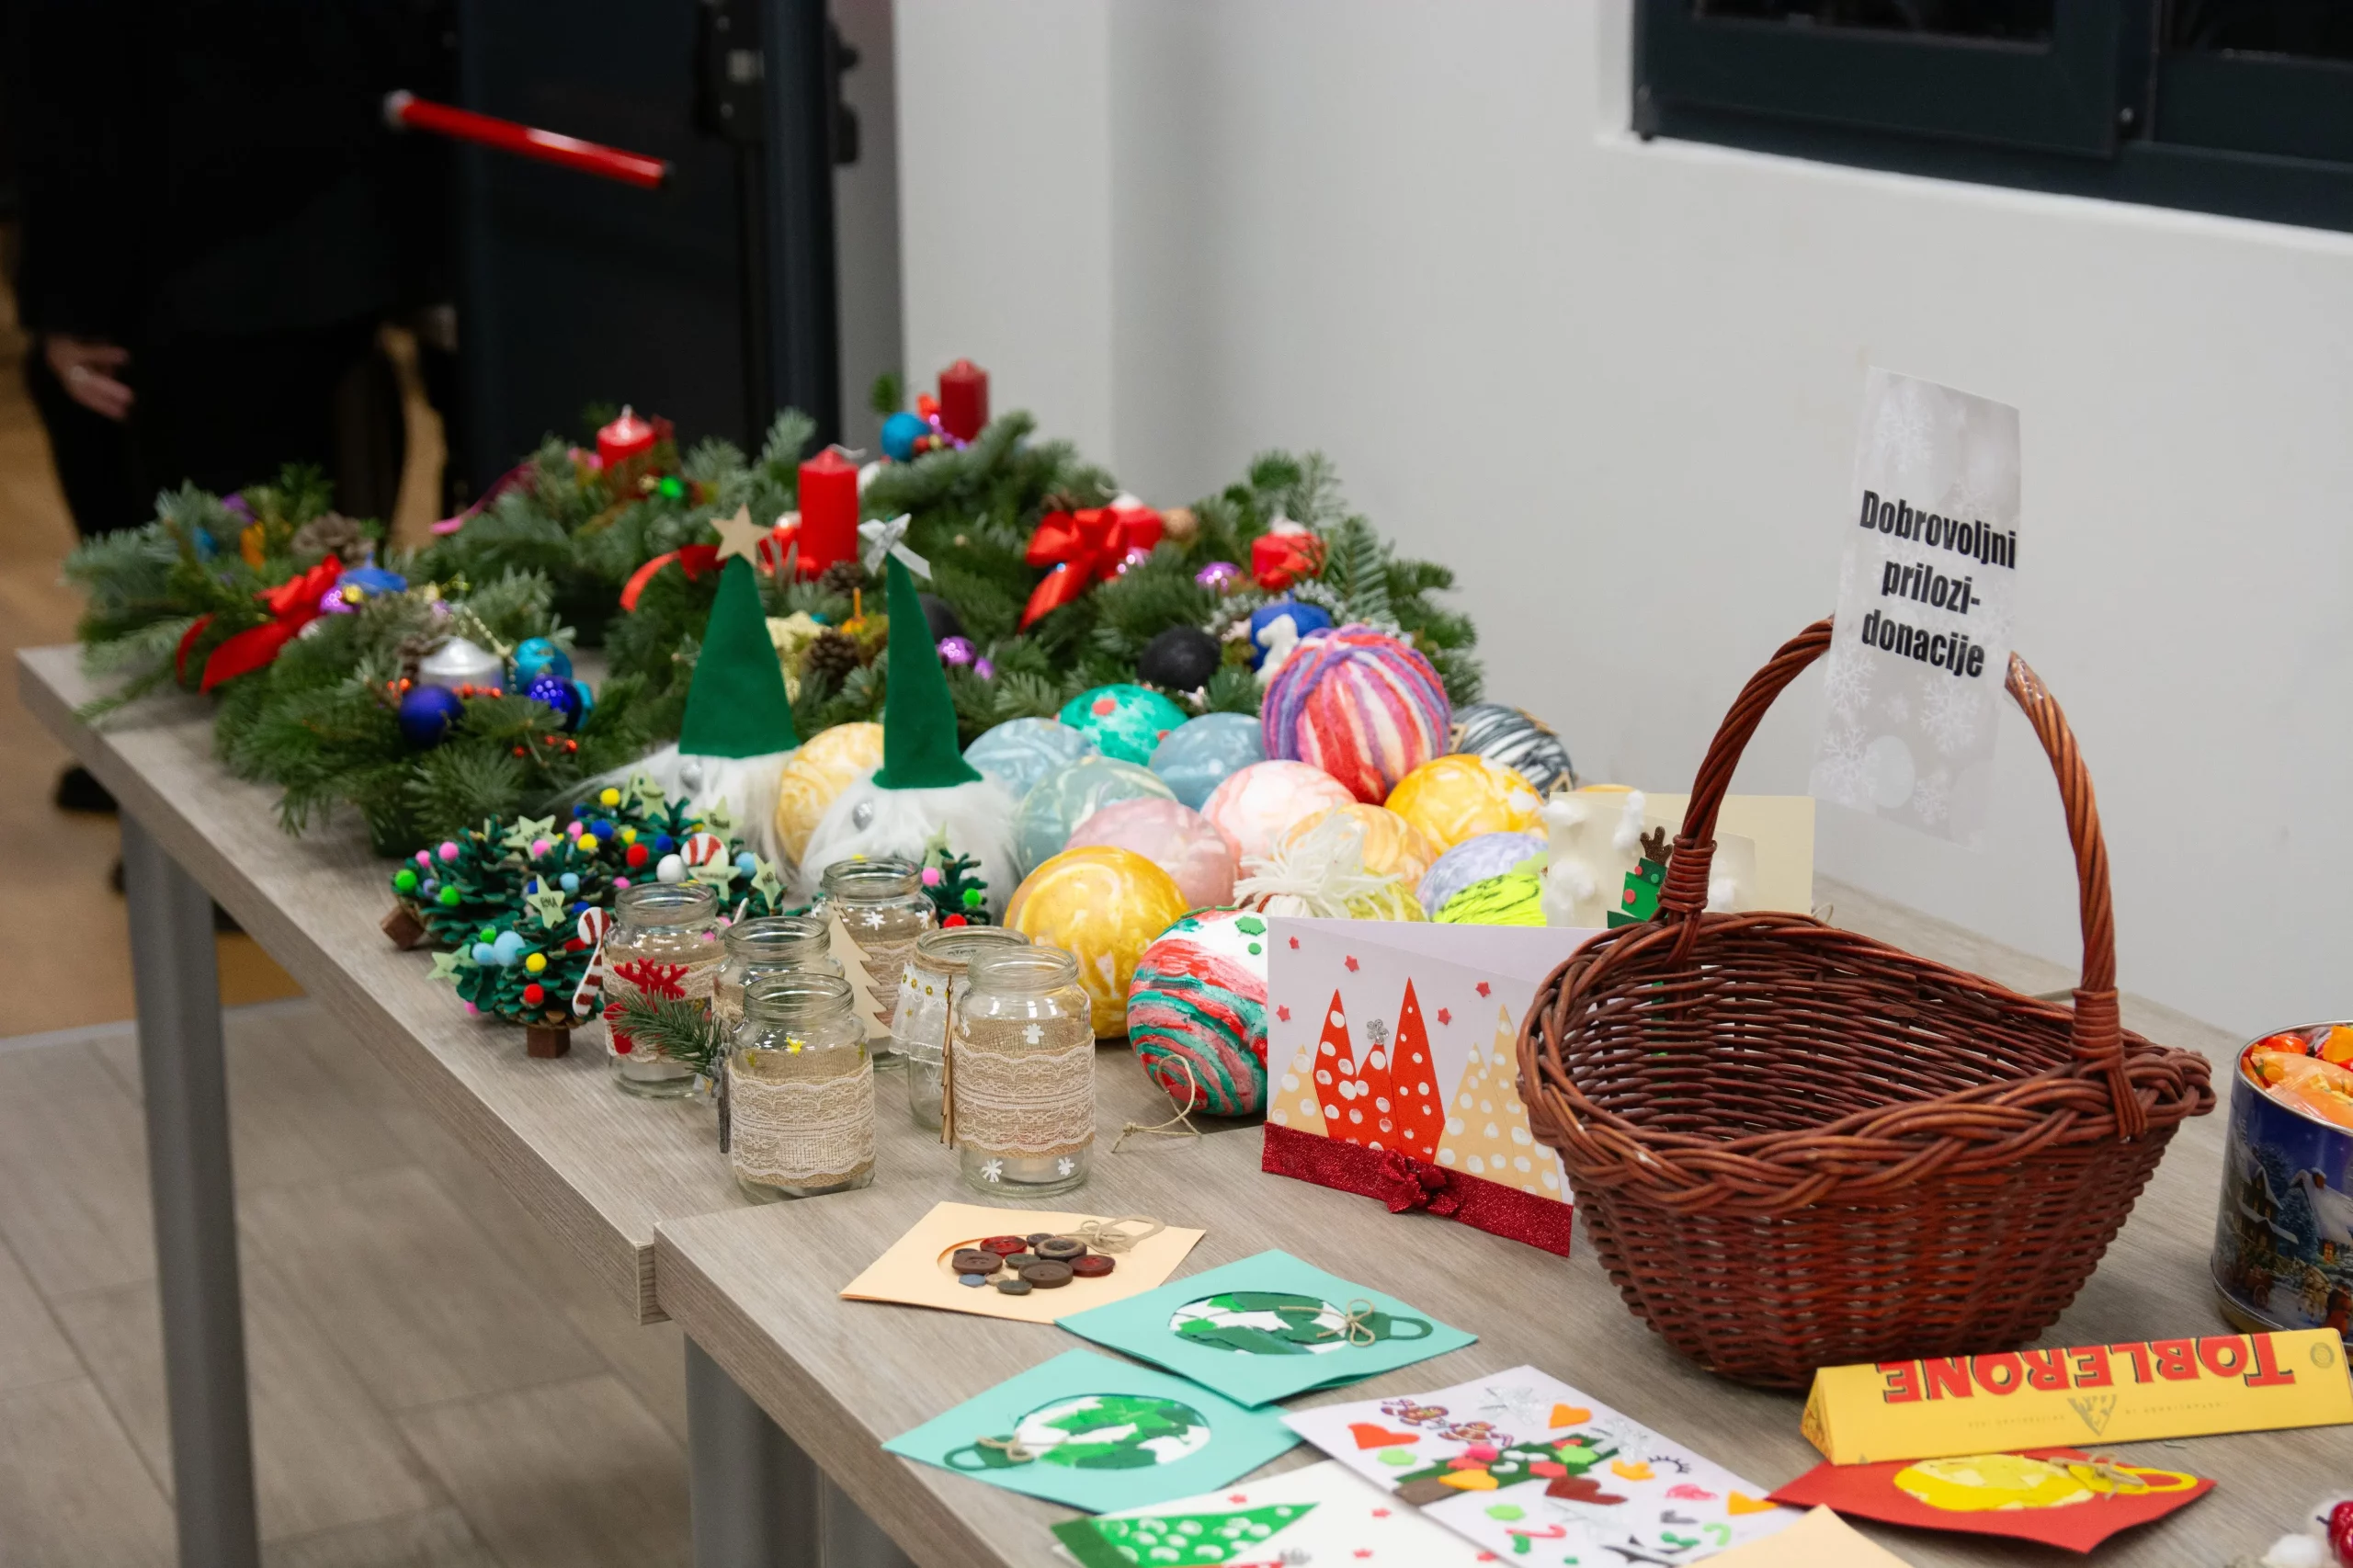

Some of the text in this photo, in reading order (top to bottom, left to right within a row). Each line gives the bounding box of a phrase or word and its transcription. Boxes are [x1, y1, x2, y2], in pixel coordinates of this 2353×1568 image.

[1859, 489, 2017, 570] Dobrovoljni
[1881, 560, 1981, 615] prilozi-
[1861, 608, 1985, 677] donacije
[1875, 1332, 2297, 1404] TOBLERONE
